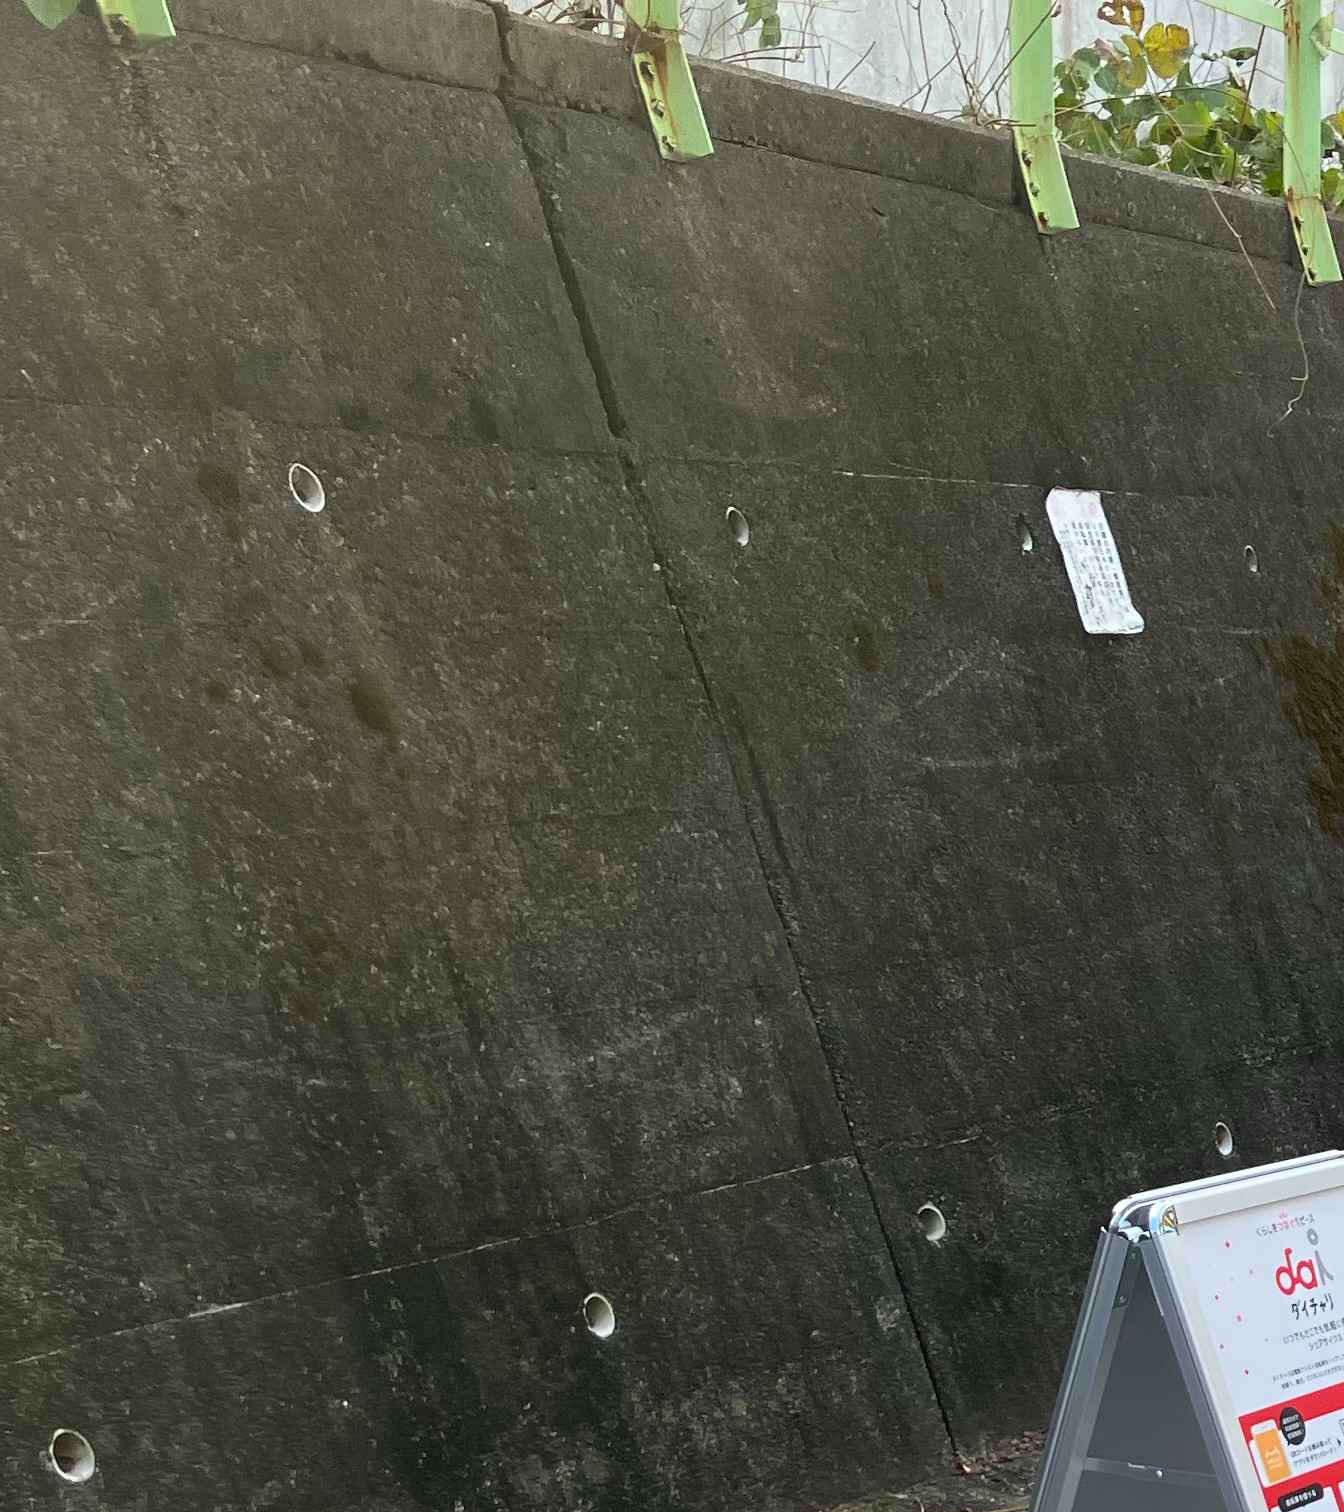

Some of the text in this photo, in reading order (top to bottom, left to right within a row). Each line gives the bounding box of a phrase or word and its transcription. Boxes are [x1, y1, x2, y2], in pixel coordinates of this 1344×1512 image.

[1291, 1293, 1334, 1320] ダイチャリ
